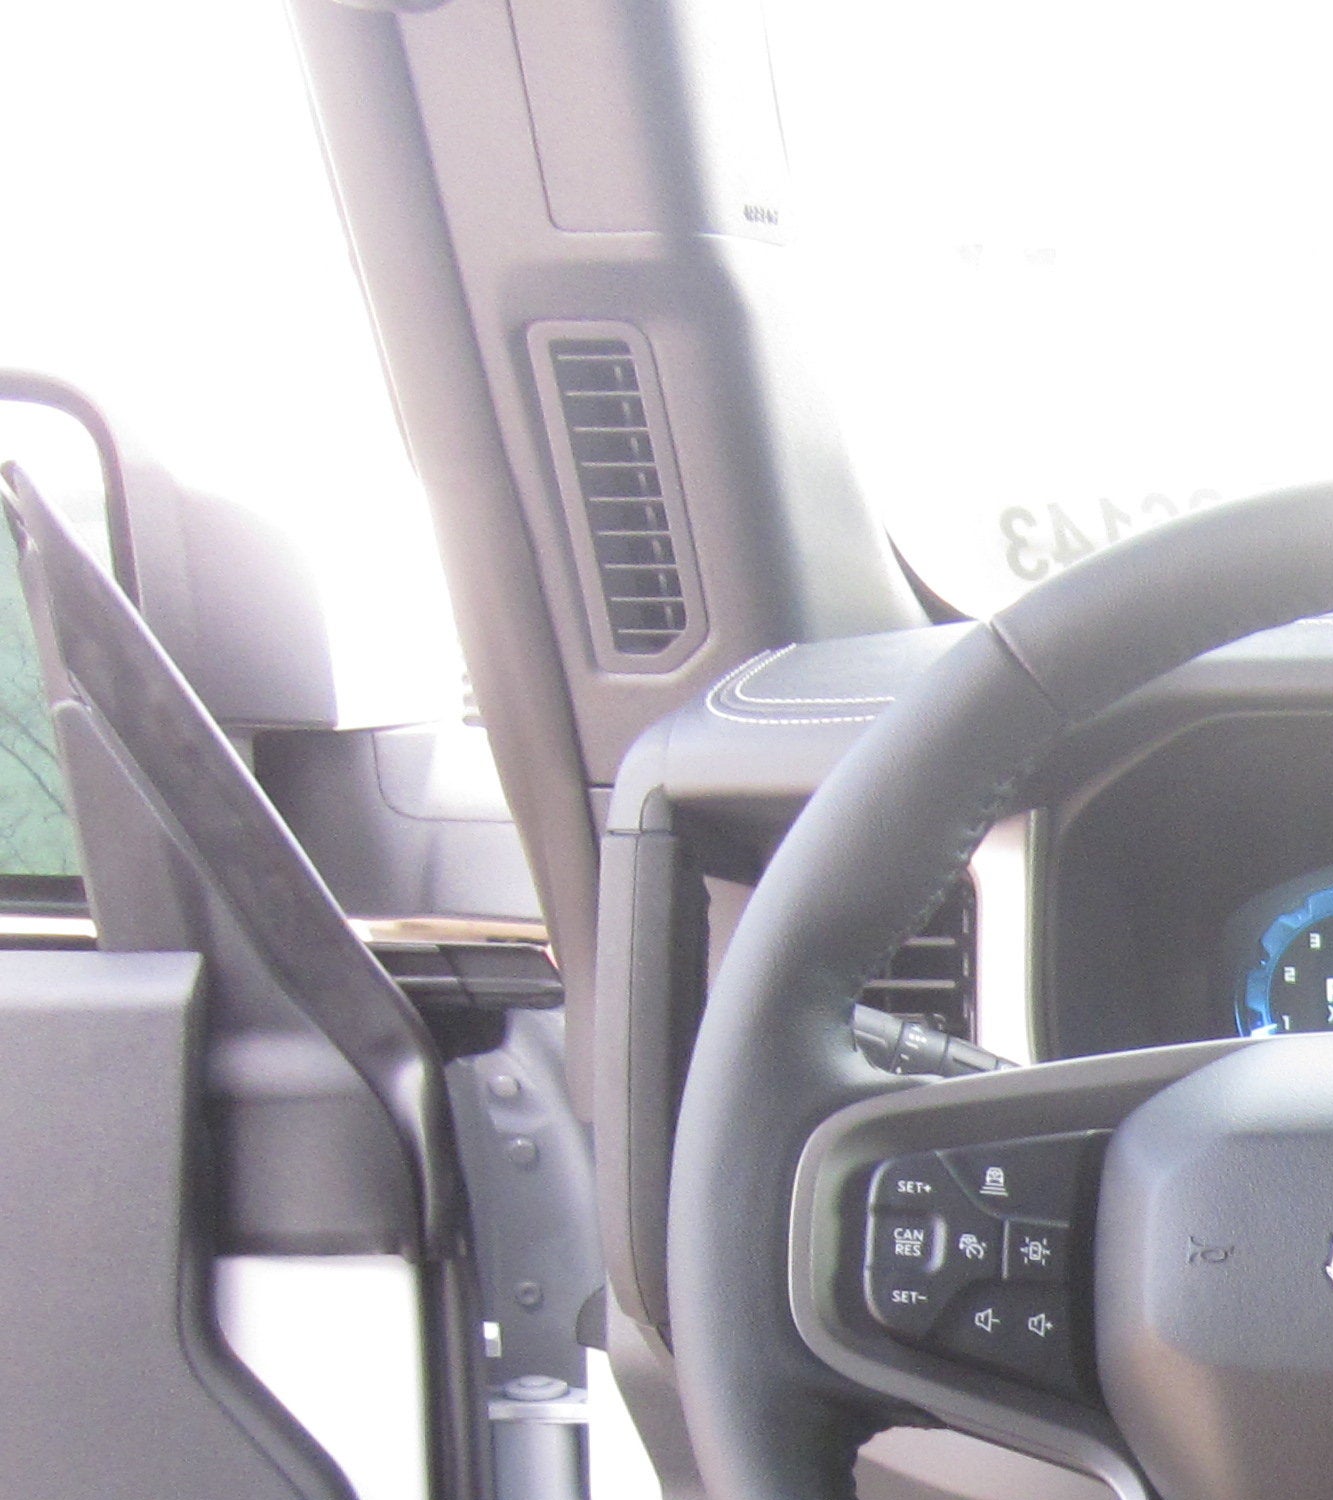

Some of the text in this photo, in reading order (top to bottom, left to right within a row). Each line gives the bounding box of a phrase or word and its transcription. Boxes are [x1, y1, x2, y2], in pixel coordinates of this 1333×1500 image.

[1308, 933, 1322, 949] 3
[1284, 966, 1296, 983] 2
[1281, 1015, 1291, 1030] 1
[893, 1227, 925, 1242] CAN
[895, 1244, 922, 1257] RES
